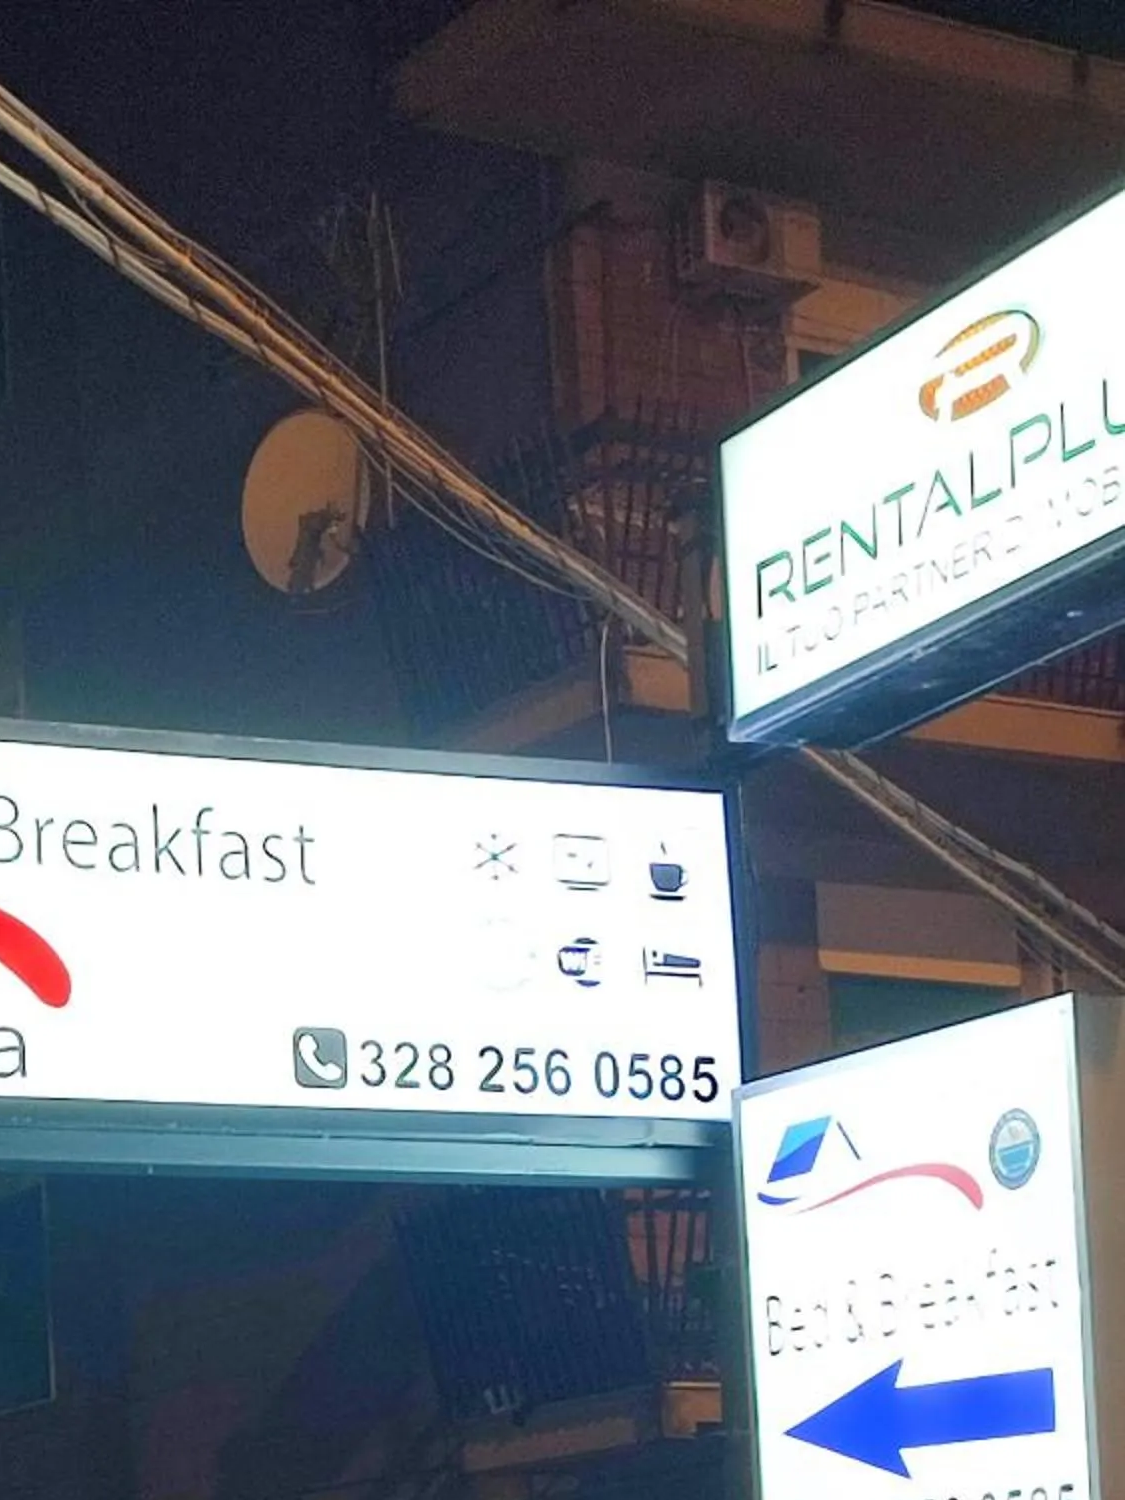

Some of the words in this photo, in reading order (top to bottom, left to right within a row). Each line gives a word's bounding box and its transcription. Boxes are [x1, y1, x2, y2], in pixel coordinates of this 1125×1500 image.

[757, 642, 779, 676] IL
[785, 605, 844, 658] TUO
[852, 529, 994, 627] PARTNER
[360, 1039, 455, 1092] 328
[478, 1044, 572, 1097] 256
[593, 1050, 720, 1104] 0585
[766, 1290, 829, 1357] Bed
